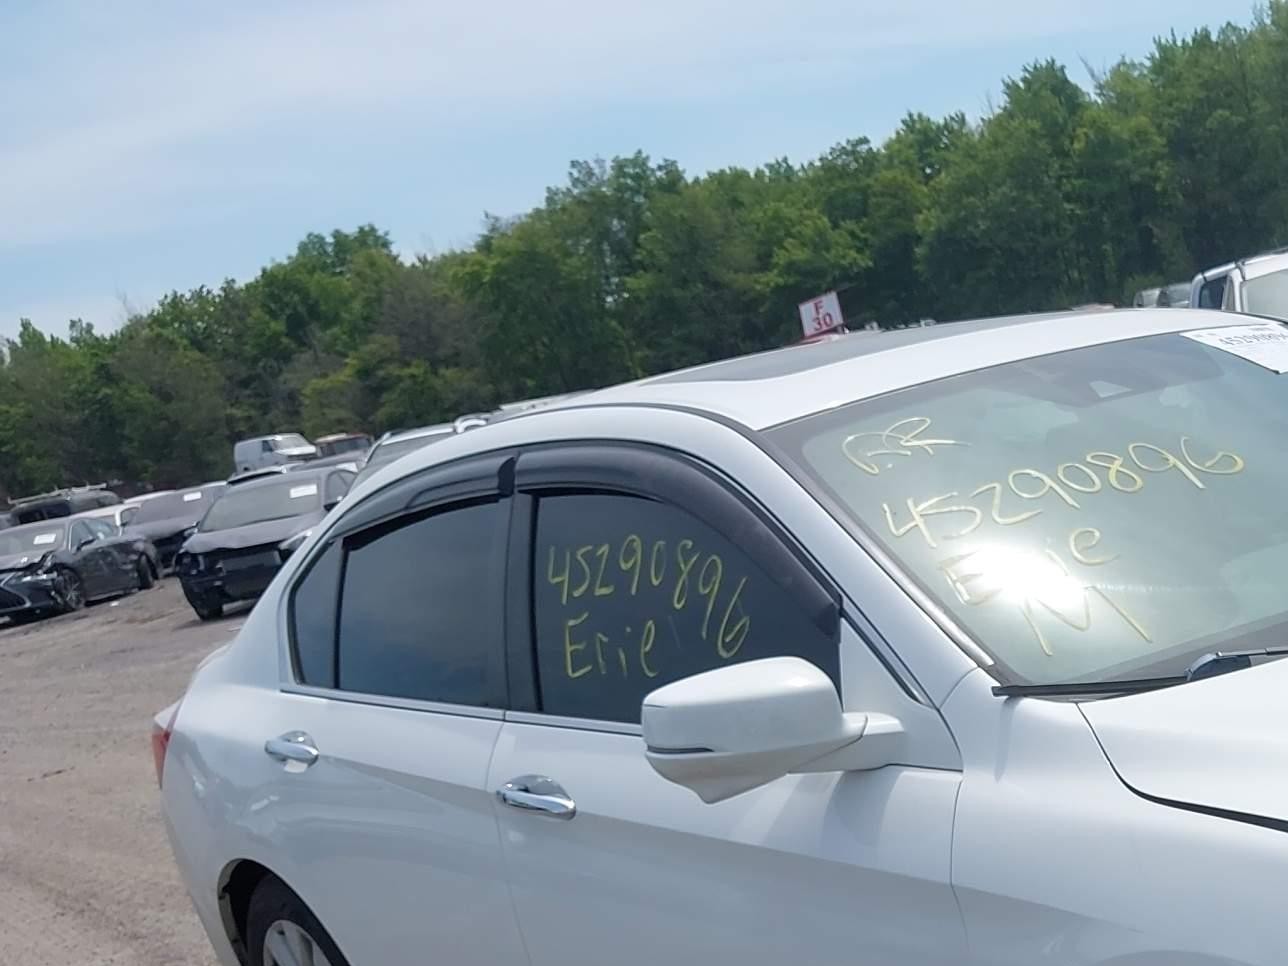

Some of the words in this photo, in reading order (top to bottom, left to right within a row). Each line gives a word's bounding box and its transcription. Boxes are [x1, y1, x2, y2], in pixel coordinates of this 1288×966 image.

[813, 300, 824, 316] F
[813, 312, 834, 331] 30
[882, 436, 1245, 548] 45290896
[548, 534, 750, 659] 45290896
[934, 526, 1121, 607] Eie
[565, 611, 657, 678] Erie
